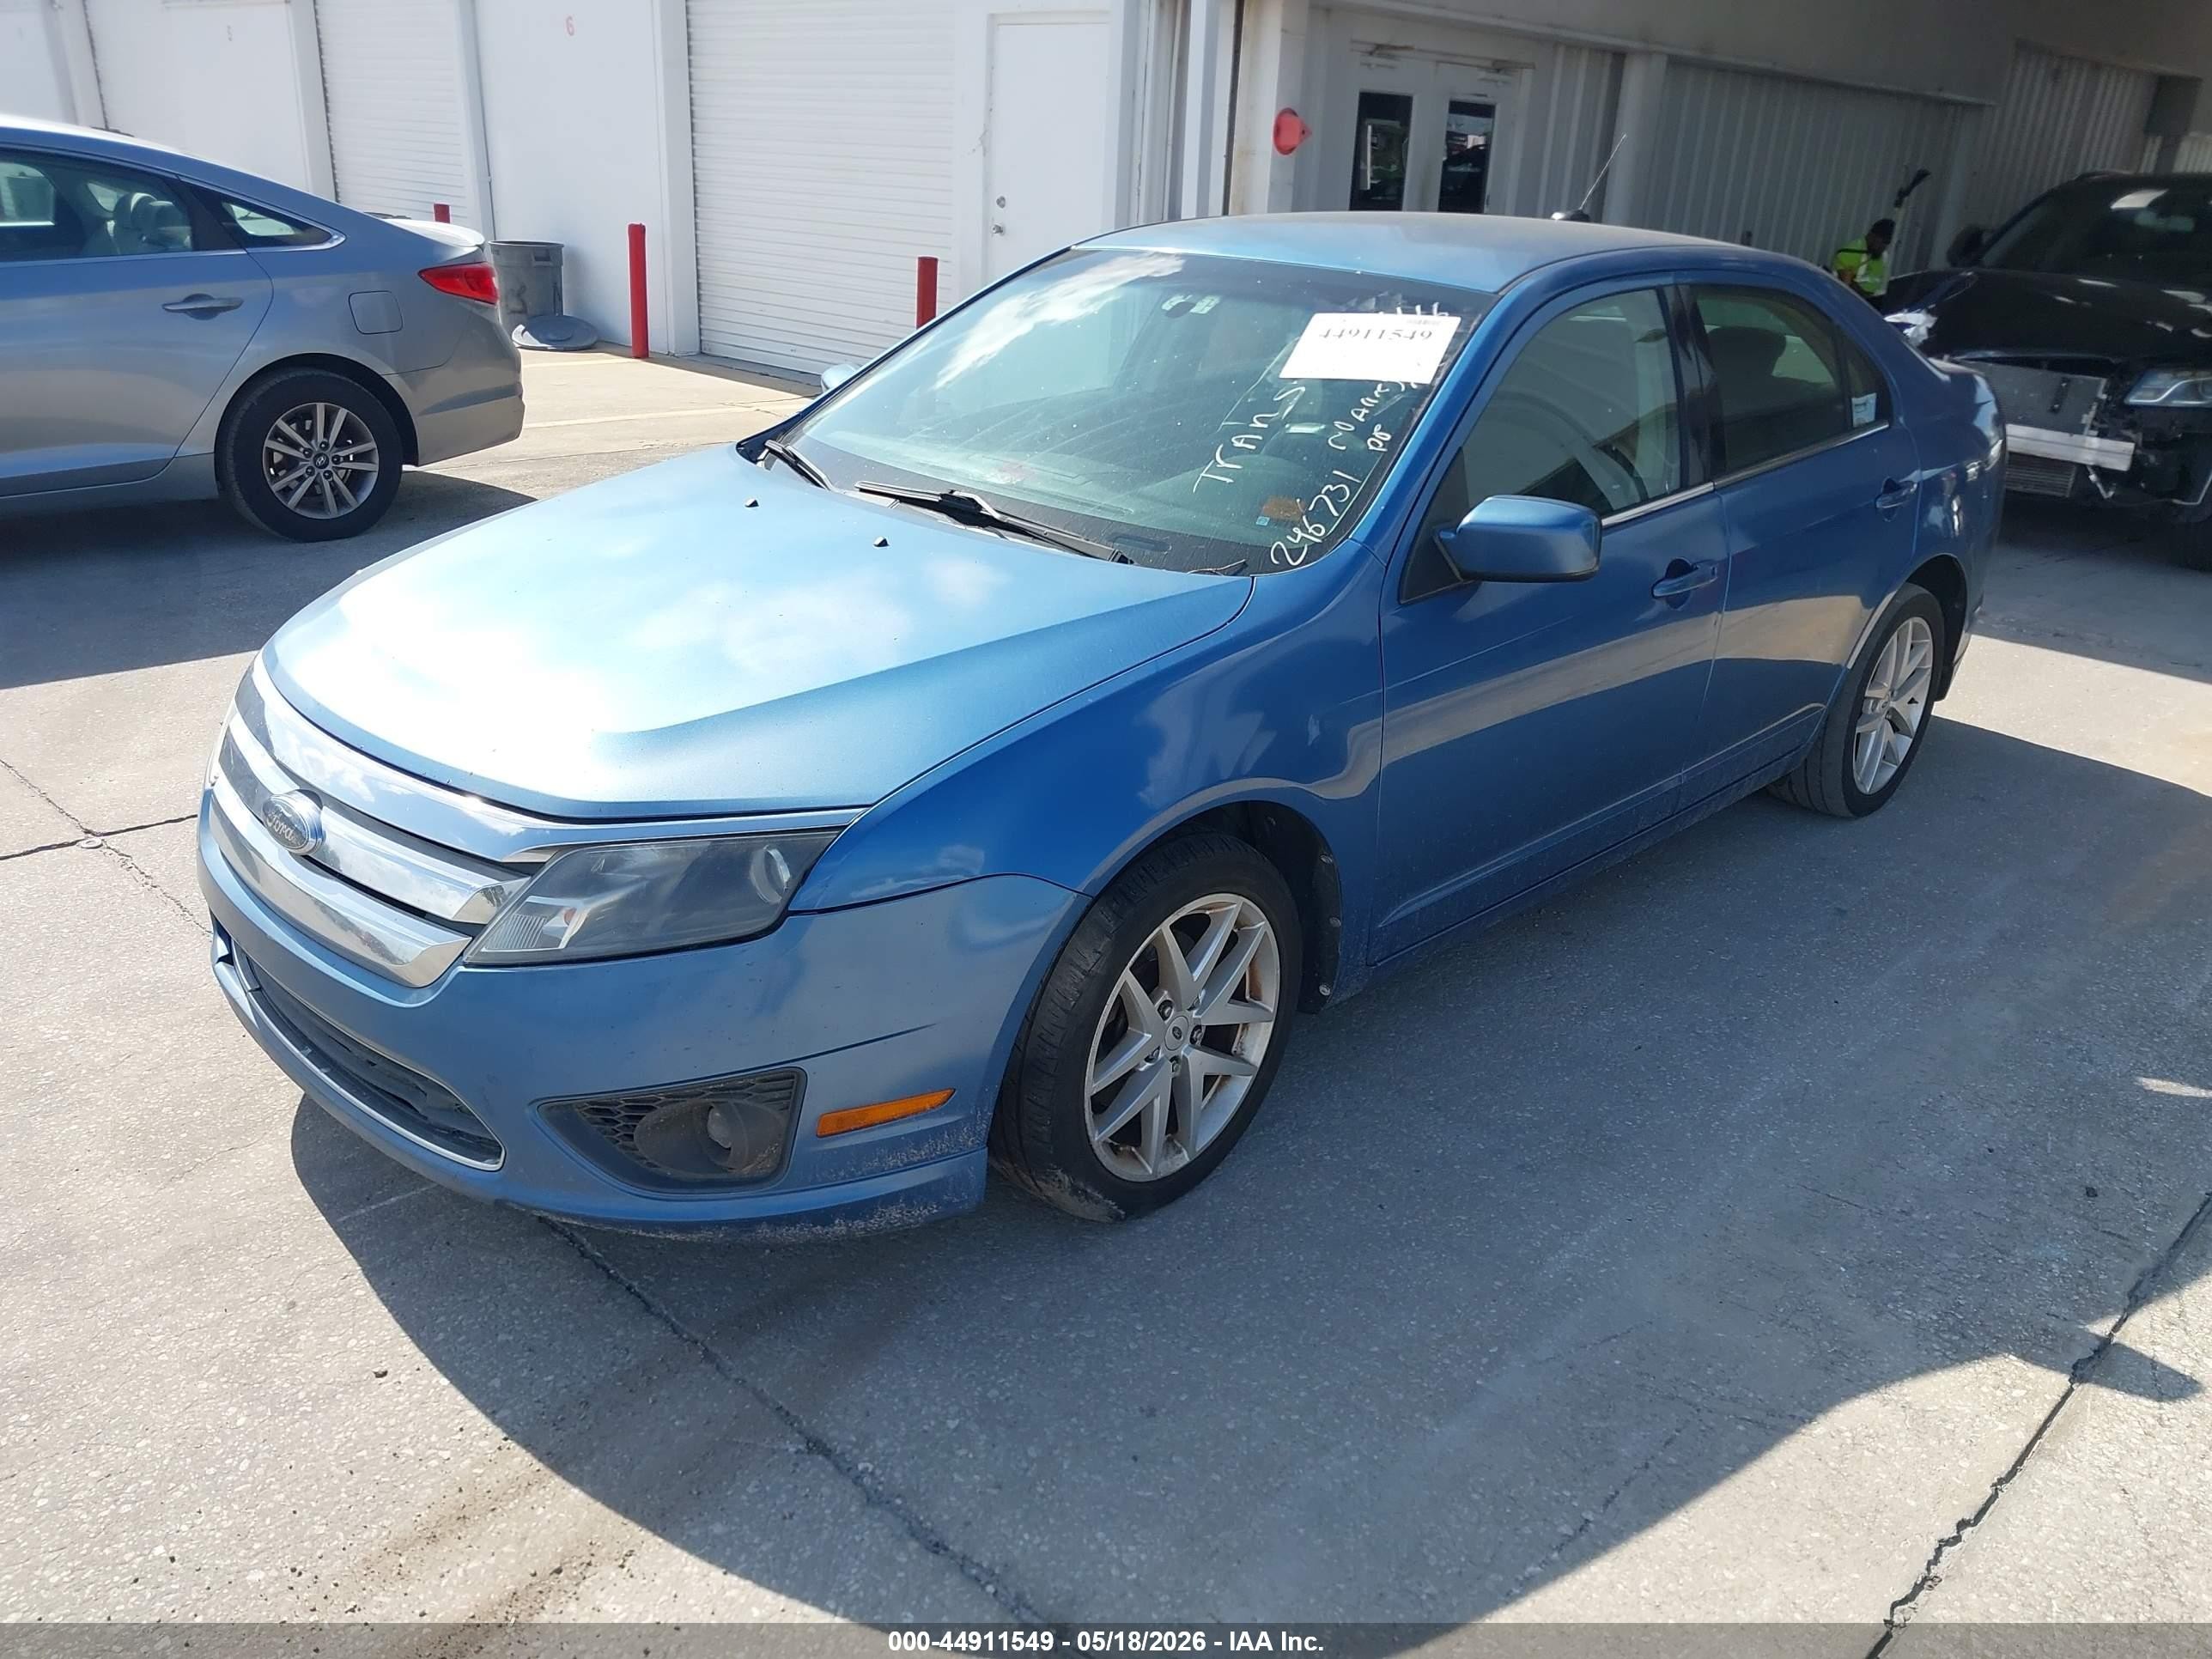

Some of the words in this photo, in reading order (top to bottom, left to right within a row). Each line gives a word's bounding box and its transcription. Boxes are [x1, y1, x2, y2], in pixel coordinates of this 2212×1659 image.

[566, 15, 575, 36] 6
[1320, 328, 1432, 340] 44911549
[1270, 470, 1362, 566] 246731
